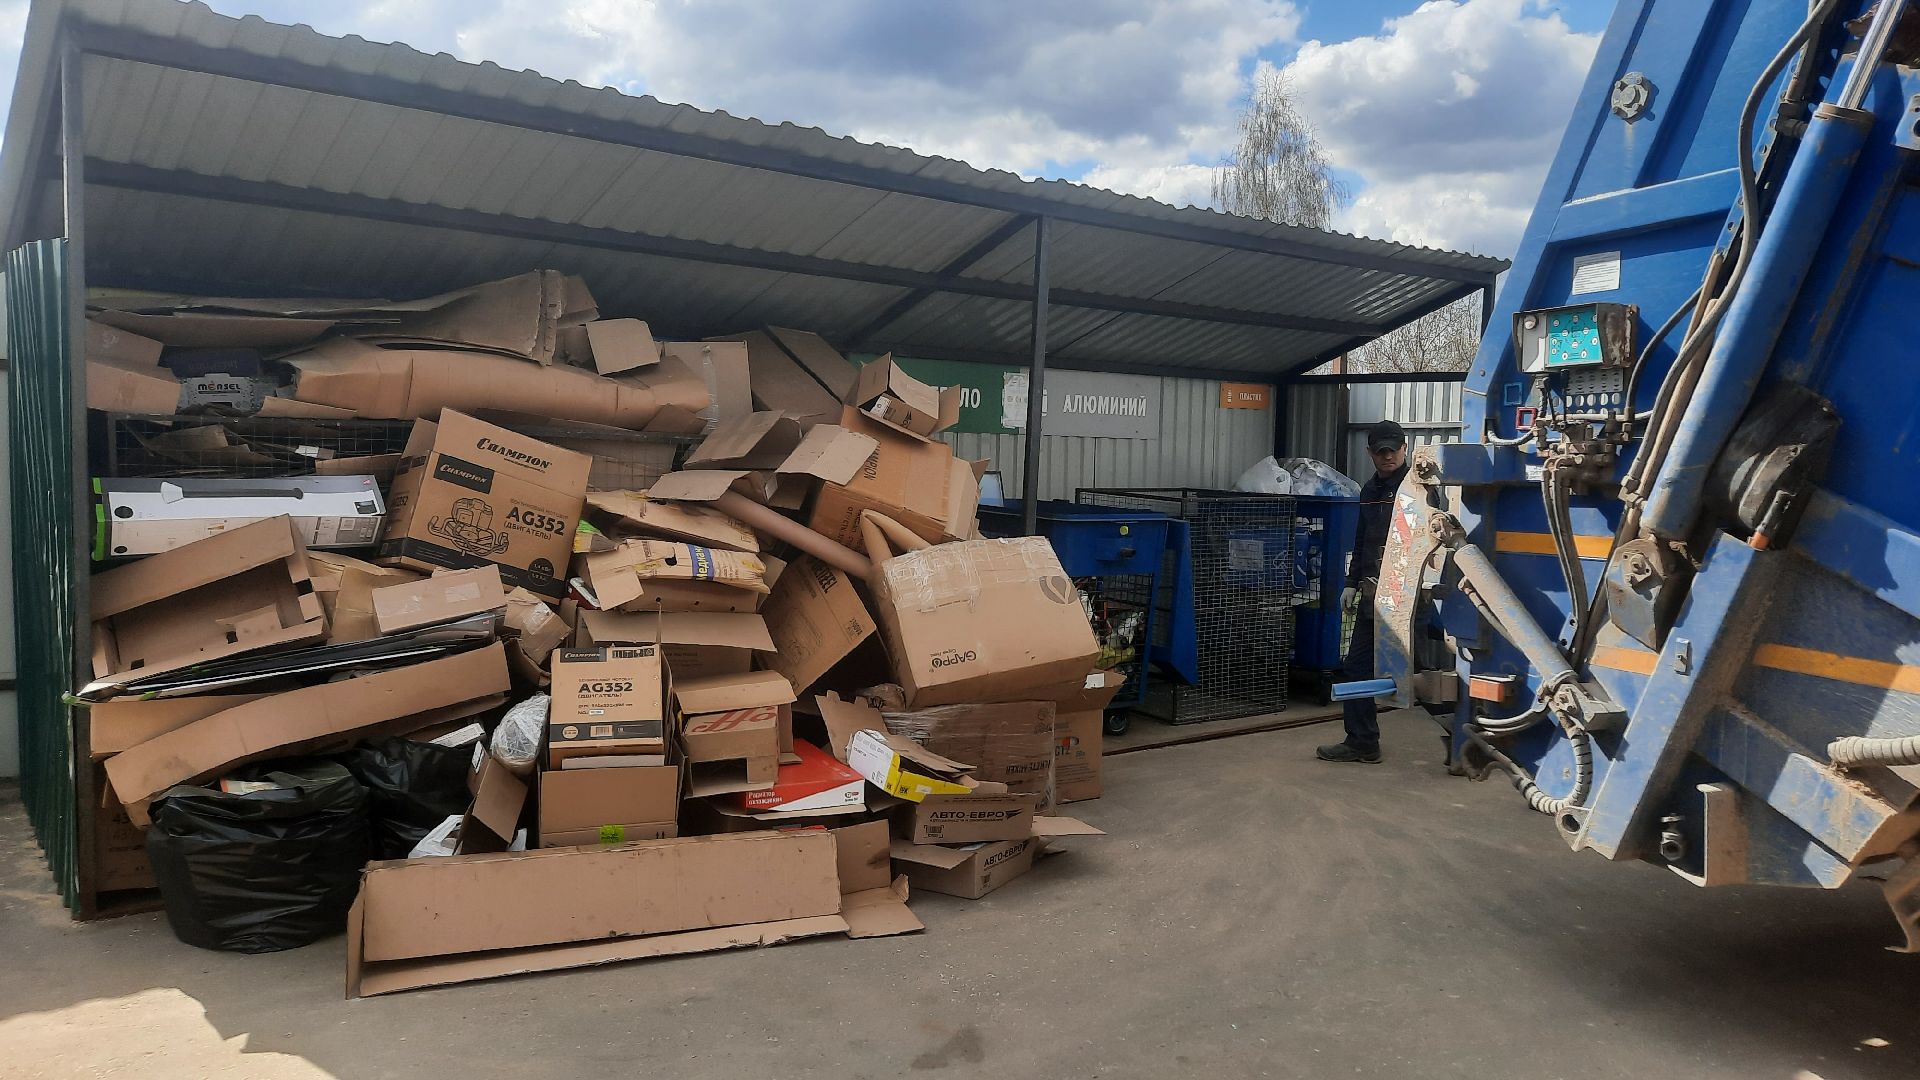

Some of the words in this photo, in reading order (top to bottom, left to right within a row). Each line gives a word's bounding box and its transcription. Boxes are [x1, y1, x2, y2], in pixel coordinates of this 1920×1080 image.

[1063, 394, 1147, 417] АЛЮМИНИЙ
[476, 437, 550, 469] CHAMPION
[439, 463, 488, 484] CHAMPION
[503, 520, 552, 541] (ДВИГАТЕЛЬ)
[506, 506, 566, 536] AG352
[931, 650, 977, 668] GAPPO
[578, 682, 633, 693] AG352
[929, 811, 1005, 819] АВТО-ЕВРО
[983, 843, 1023, 867] АВТО-ЕВРО
